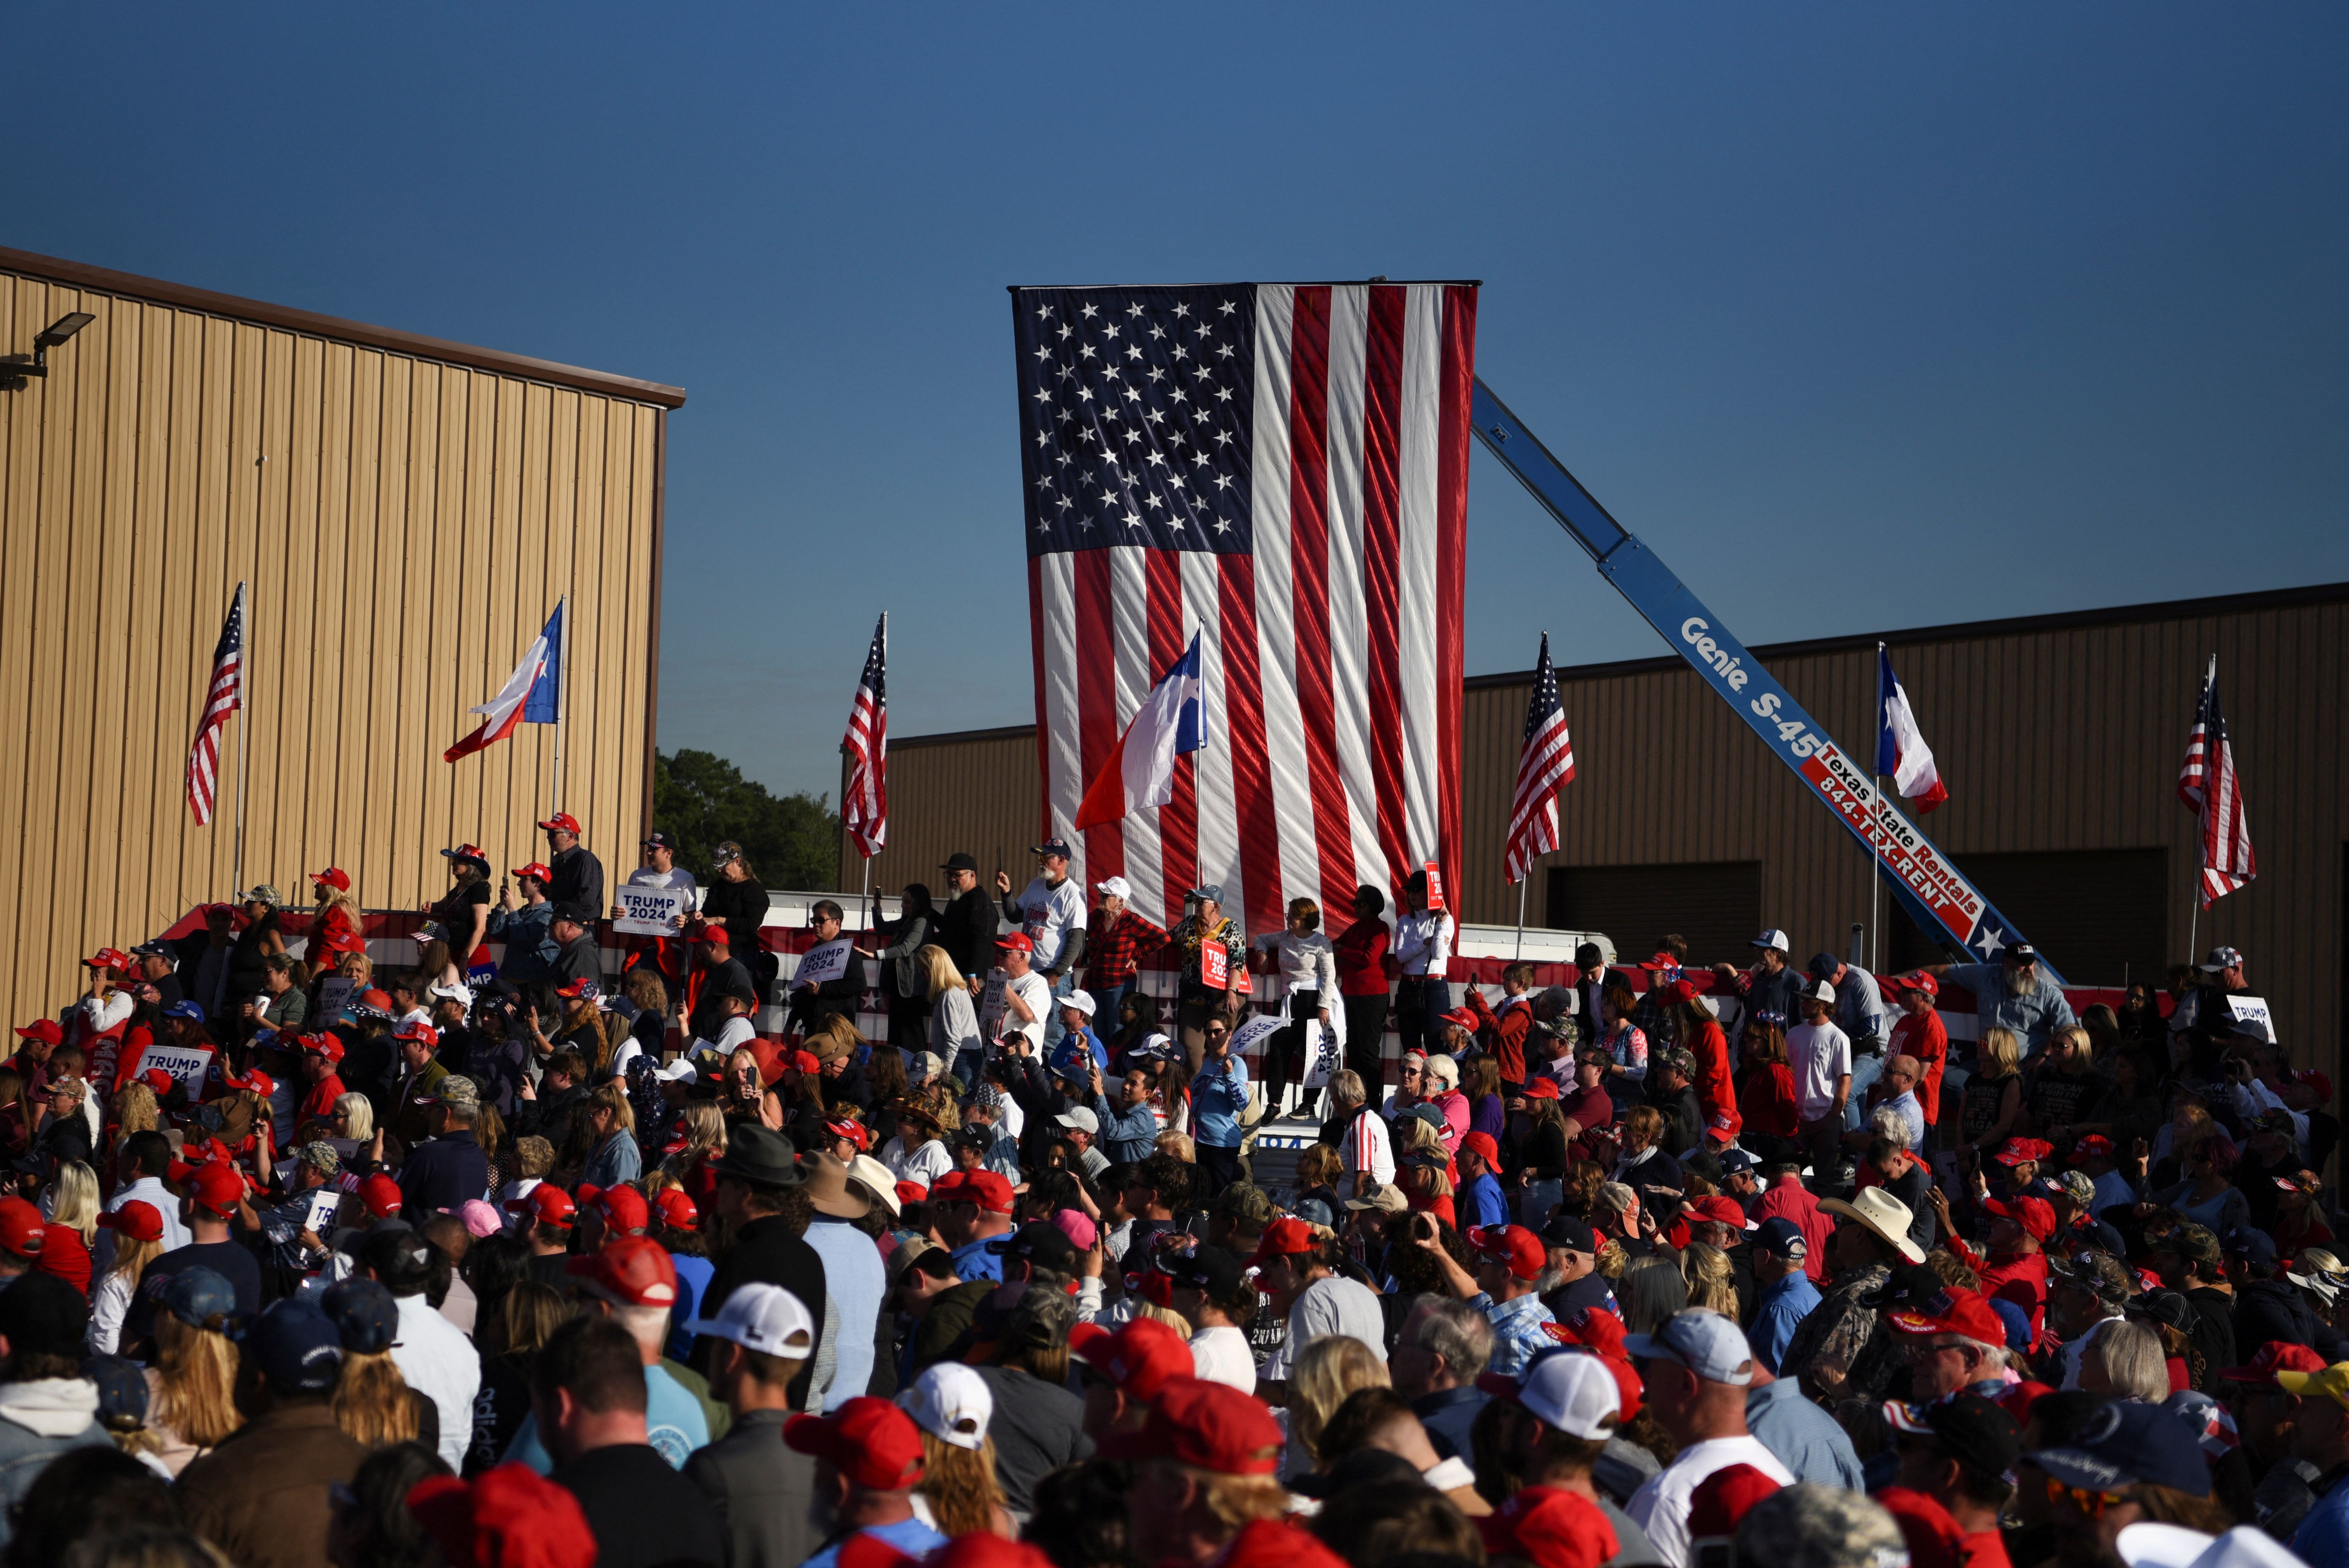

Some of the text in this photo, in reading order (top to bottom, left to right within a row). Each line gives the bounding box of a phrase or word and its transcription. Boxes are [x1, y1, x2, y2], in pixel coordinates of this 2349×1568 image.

[1681, 617, 1748, 693] Genie
[1751, 693, 1822, 758] S-45
[1822, 744, 1978, 916] Texas State Rentals
[1819, 776, 1951, 910] 844-TEX-RENT
[623, 895, 675, 909] TRUMP
[629, 907, 666, 920] 2024
[803, 948, 844, 966] TRUMP
[1207, 949, 1227, 965] TRU
[804, 958, 834, 973] 2024
[1211, 962, 1228, 977] 202
[463, 973, 492, 987] UMP
[987, 980, 1004, 992] TRUMP
[322, 988, 348, 998] TRUMP
[987, 992, 1000, 1003] 2024
[2235, 1006, 2266, 1018] TRUMP
[1233, 1022, 1262, 1045] 2024
[1237, 1020, 1281, 1049] TRUMP
[1318, 1034, 1327, 1073] 2024
[89, 1039, 117, 1102] MAG
[147, 1055, 200, 1071] TRUMP
[2036, 1081, 2084, 1094] AMERICAN
[1785, 1235, 1799, 1246] DONALD
[2328, 1277, 2349, 1288] PRESIDEN
[1545, 1328, 1559, 1339] 2024
[473, 1387, 498, 1464] adida
